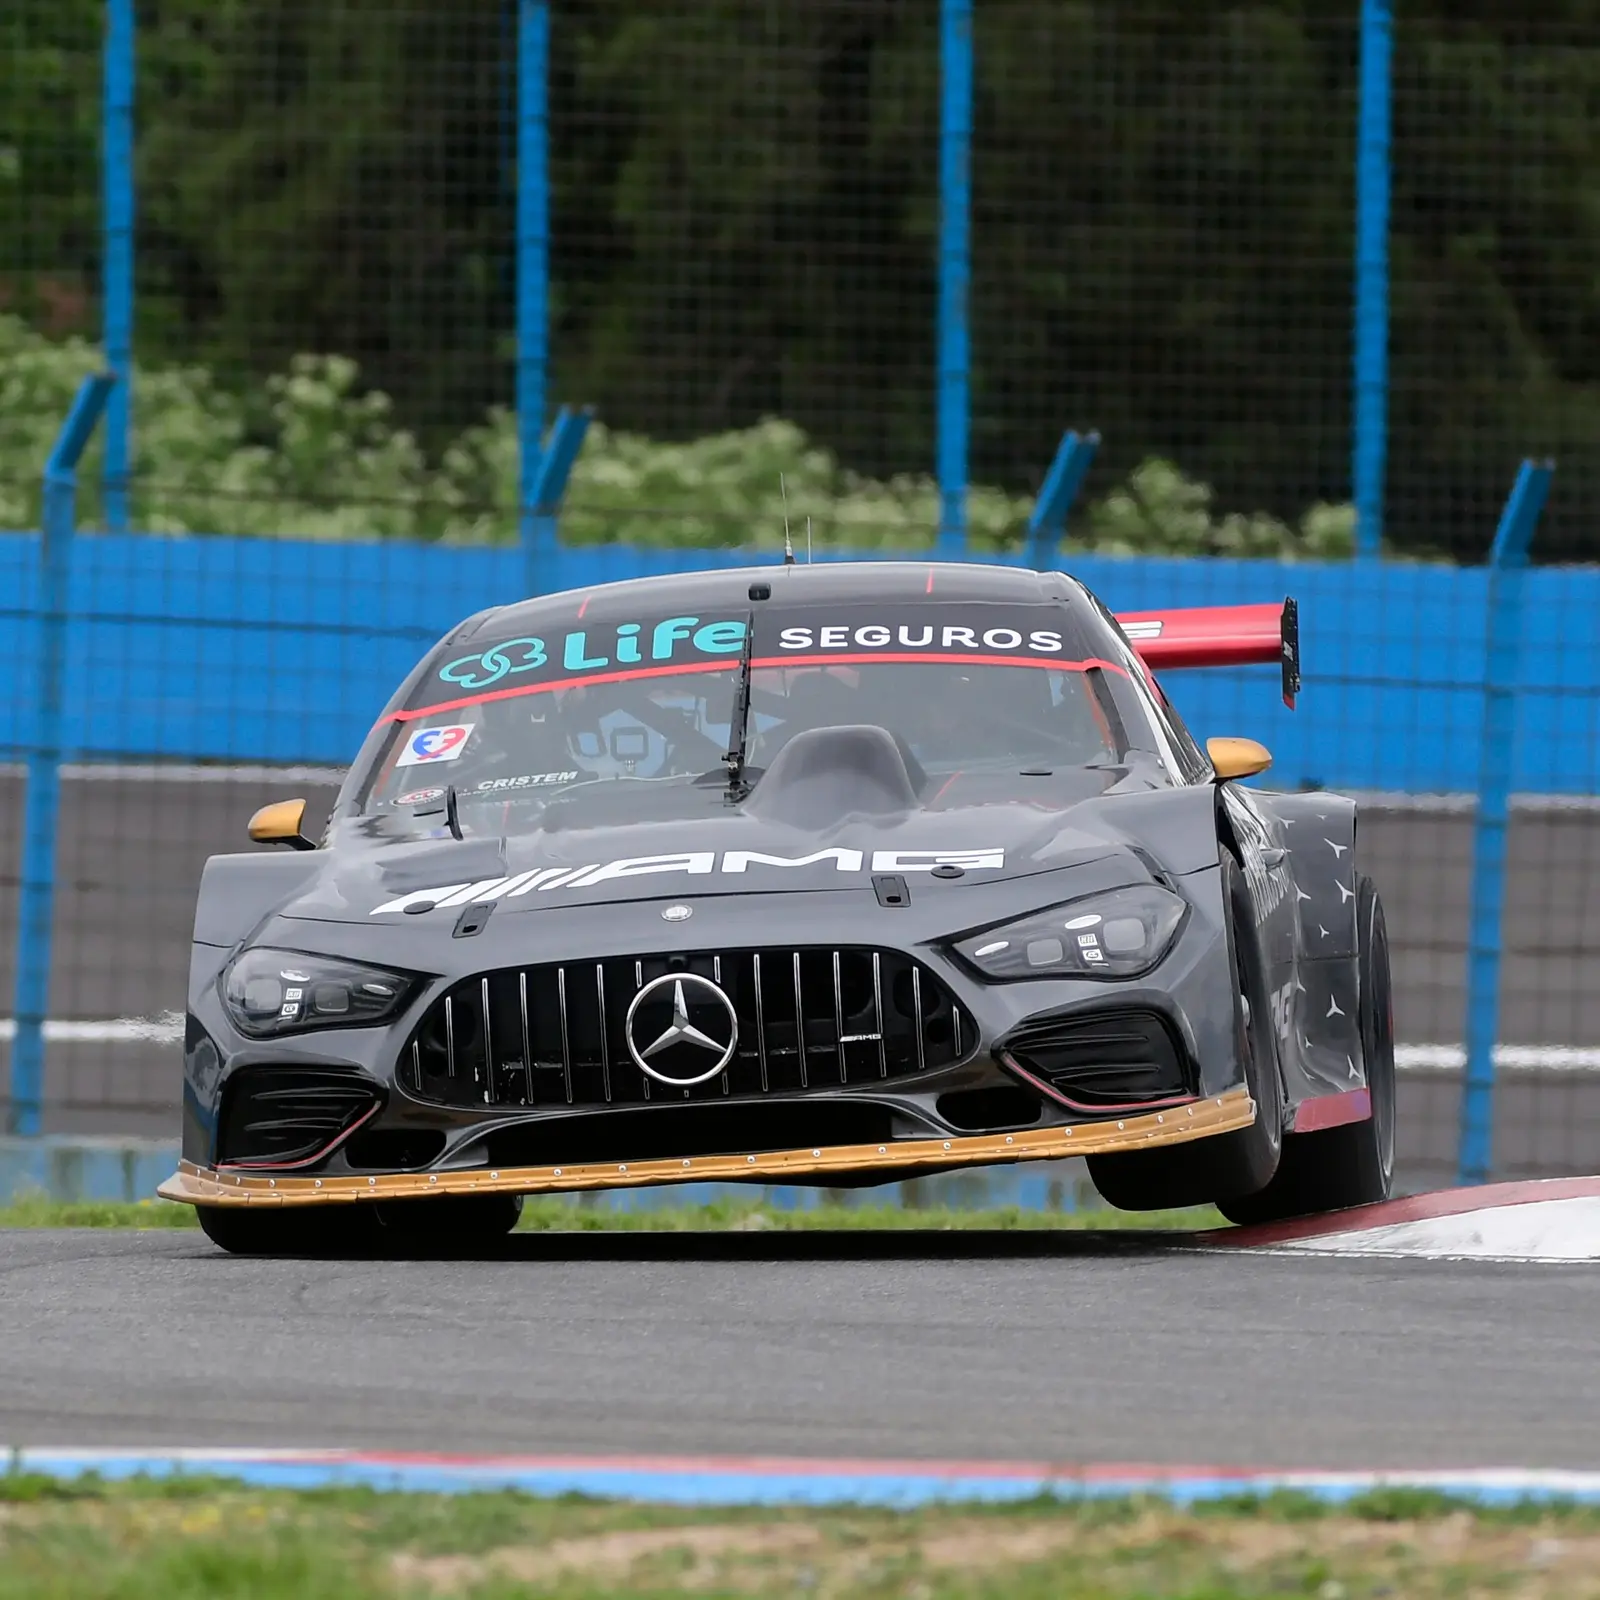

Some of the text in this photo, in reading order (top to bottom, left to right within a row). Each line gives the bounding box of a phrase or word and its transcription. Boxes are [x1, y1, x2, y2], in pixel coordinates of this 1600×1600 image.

[564, 617, 1063, 670] Life SEGUROS
[478, 771, 578, 790] CRISTEM
[565, 847, 1005, 888] AMG
